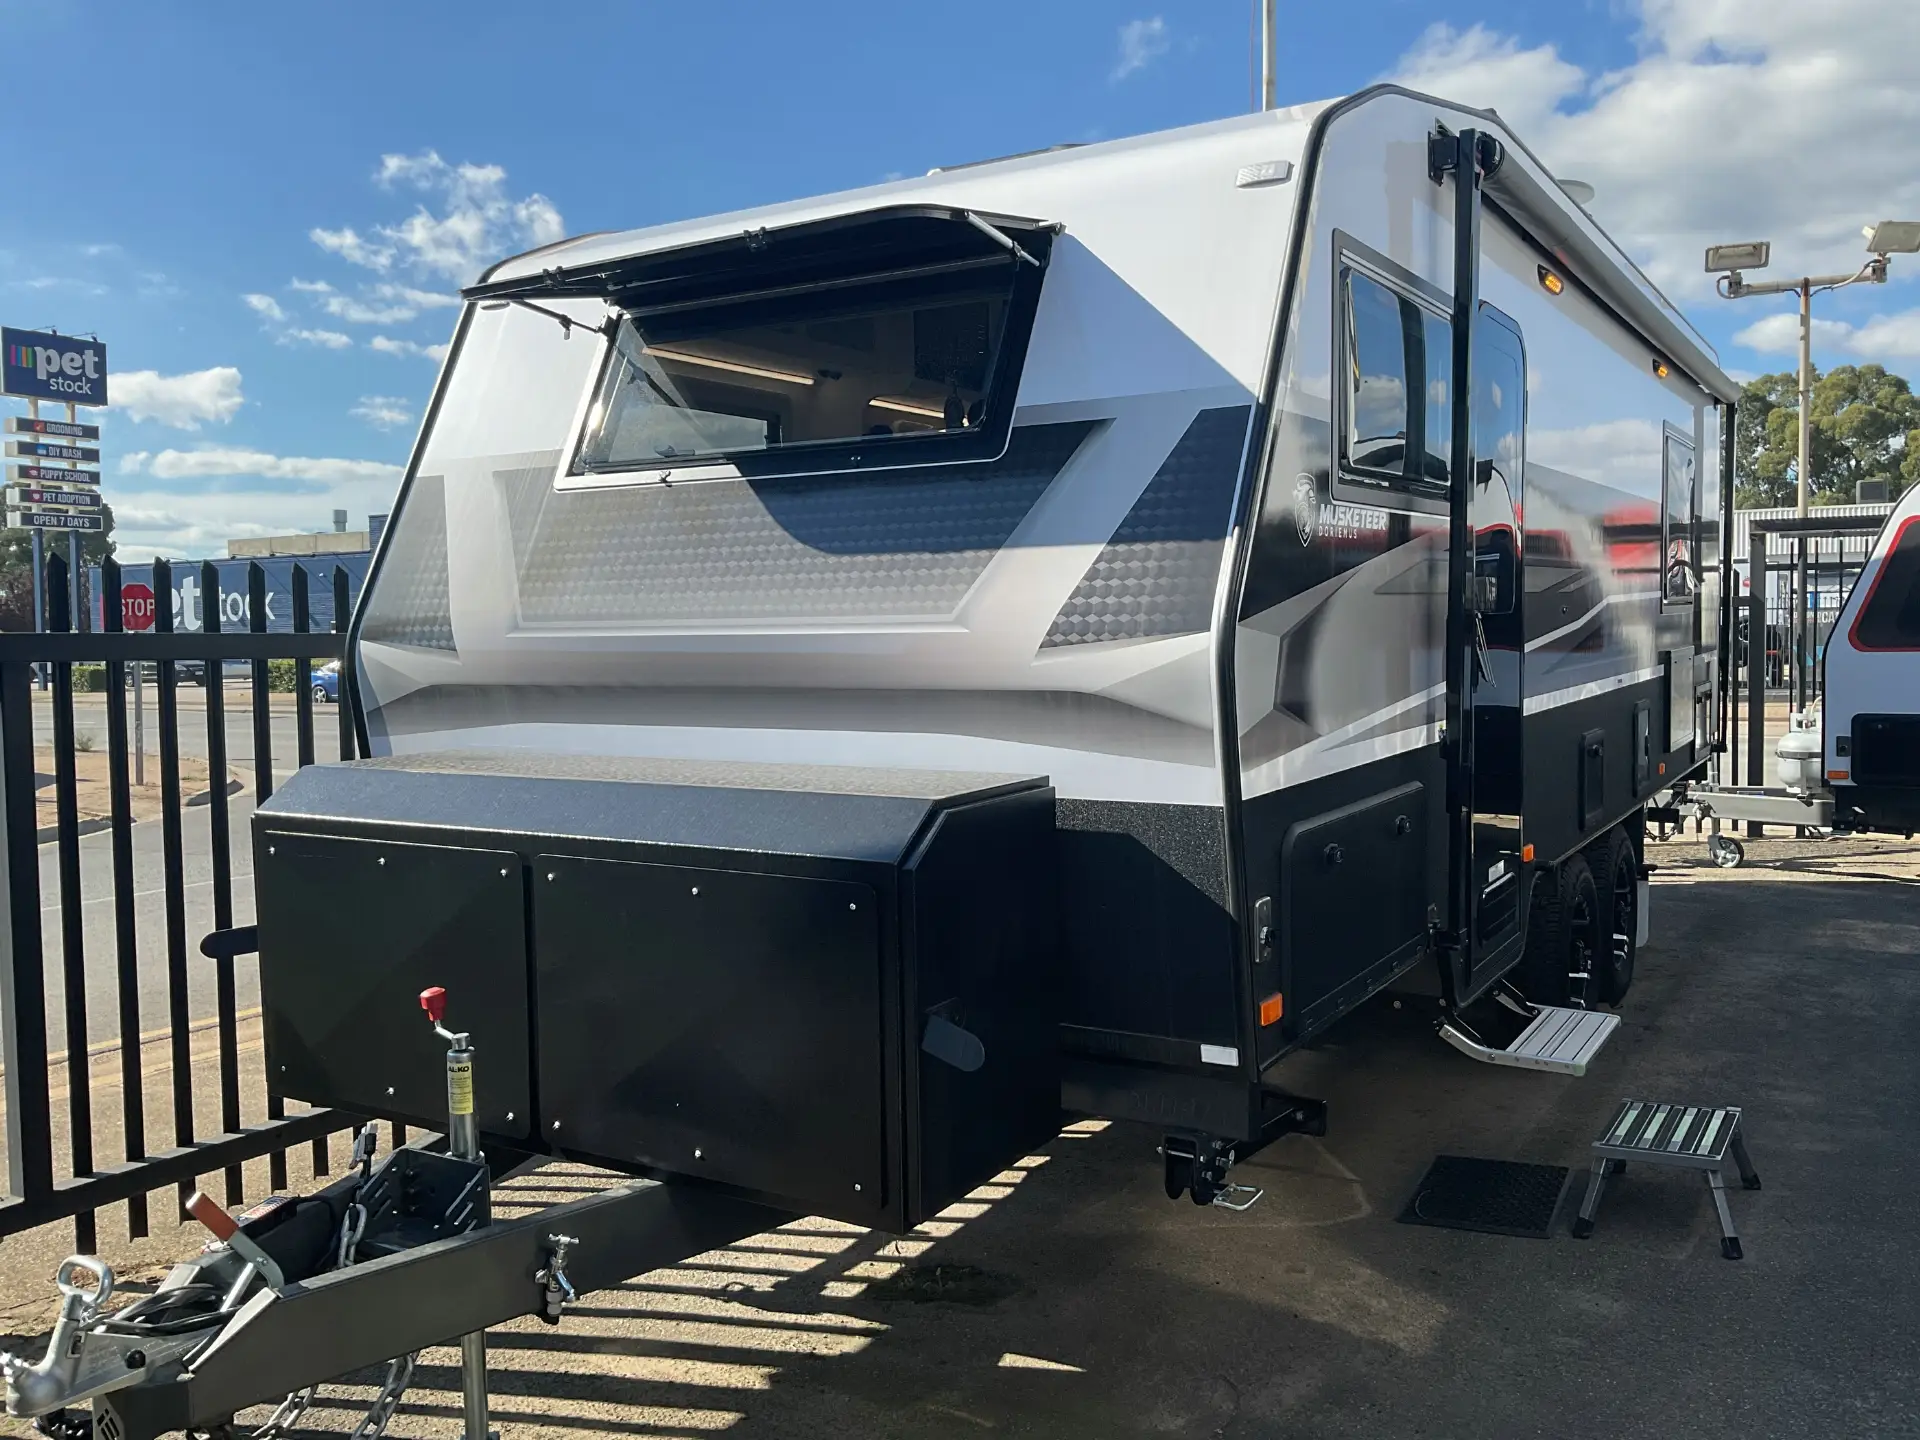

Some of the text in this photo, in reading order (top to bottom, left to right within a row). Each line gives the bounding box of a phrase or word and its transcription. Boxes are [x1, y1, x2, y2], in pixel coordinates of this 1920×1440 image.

[33, 346, 100, 380] pet
[49, 376, 92, 395] stock
[46, 422, 83, 436] GROOMING
[48, 446, 82, 459] DIY WASH
[40, 469, 91, 482] PUPPY SCHOOL
[42, 492, 91, 505] PET ADOPTION
[33, 515, 90, 528] OPEN 7 DAYS
[1319, 503, 1387, 531] MUSKETEER
[1318, 525, 1358, 540] DORIEMUS
